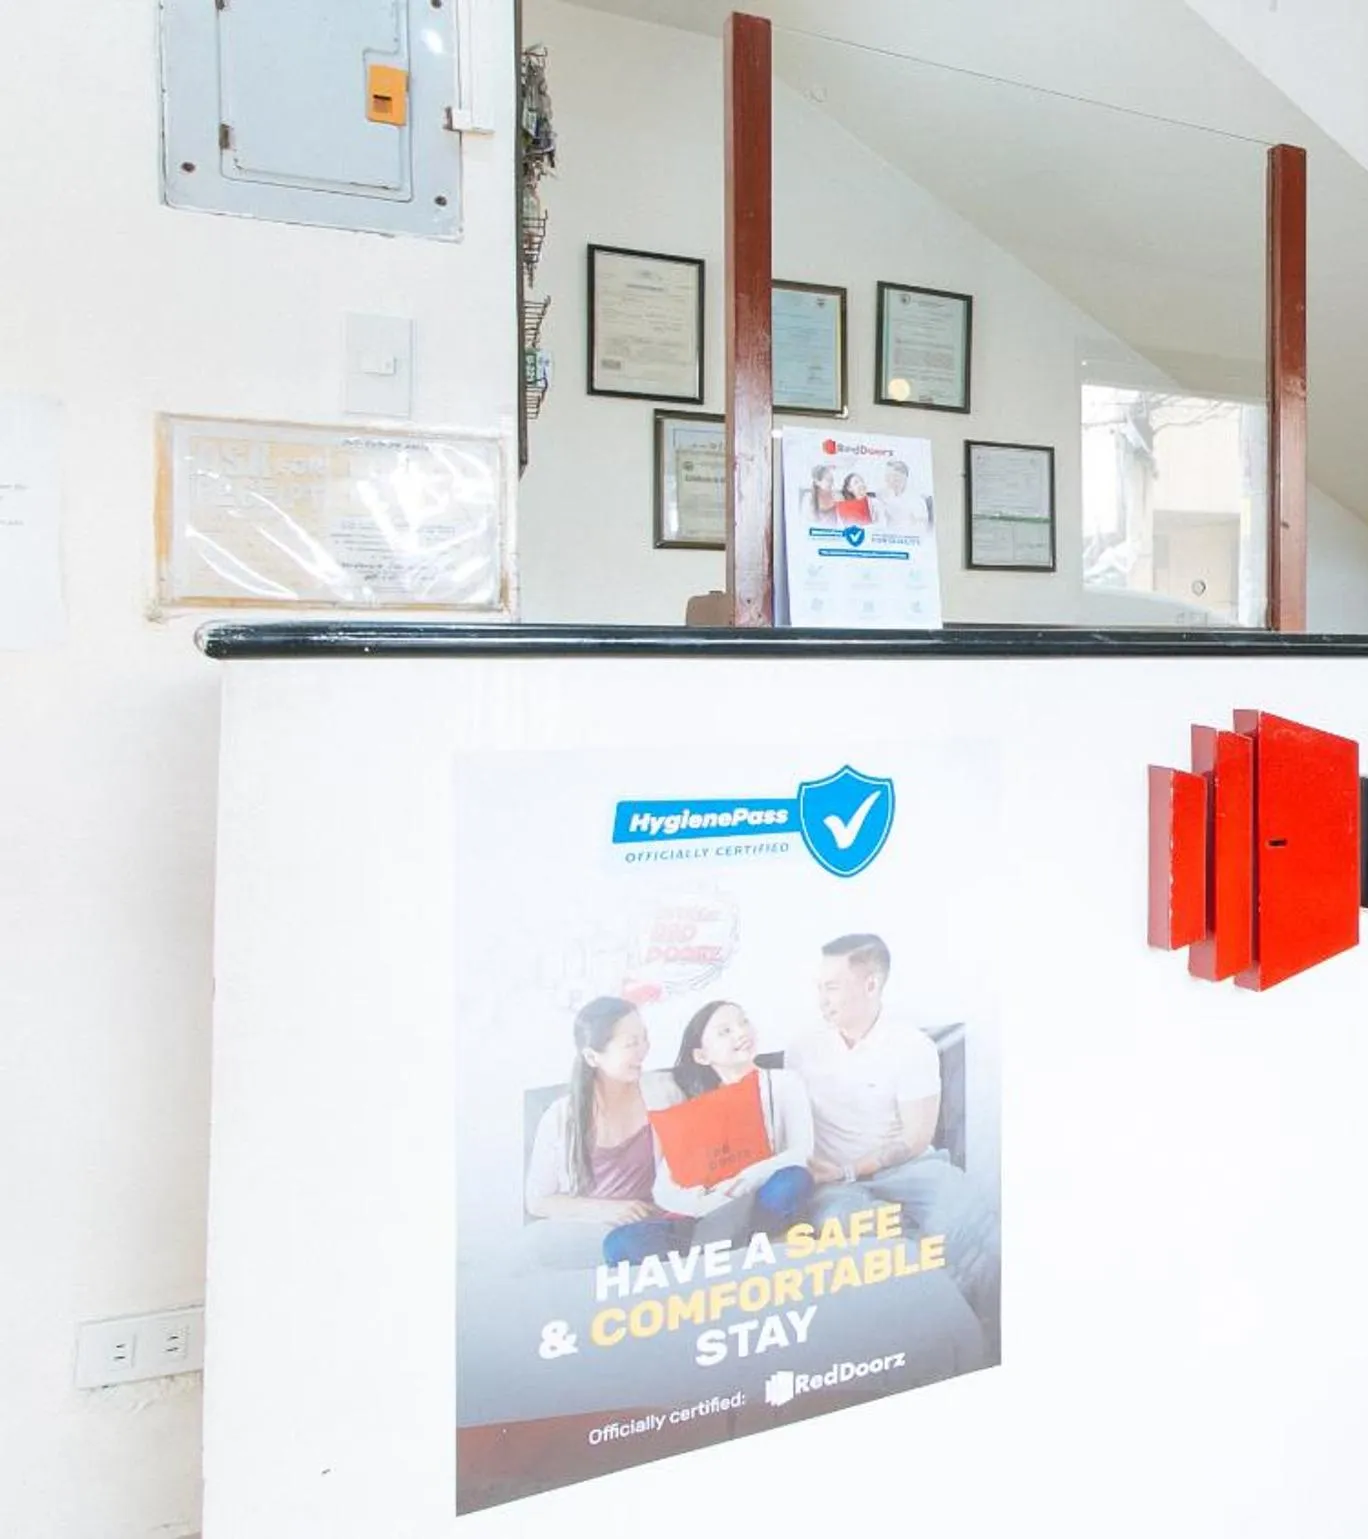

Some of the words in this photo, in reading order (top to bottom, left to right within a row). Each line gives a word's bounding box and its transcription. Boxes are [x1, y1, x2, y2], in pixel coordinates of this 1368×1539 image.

[625, 848, 709, 863] OFFICIALLY
[715, 842, 789, 857] CERTIFIED
[629, 807, 788, 835] HygienePass
[595, 1239, 732, 1301] HAVE
[742, 1231, 776, 1270] A
[785, 1204, 902, 1259] SAFE
[538, 1320, 578, 1360] &
[589, 1234, 946, 1347] COMFORTABLE
[695, 1306, 818, 1366] STAY
[588, 1414, 667, 1445] Officially
[670, 1391, 746, 1424] certified:
[795, 1352, 906, 1394] RedDoorz
